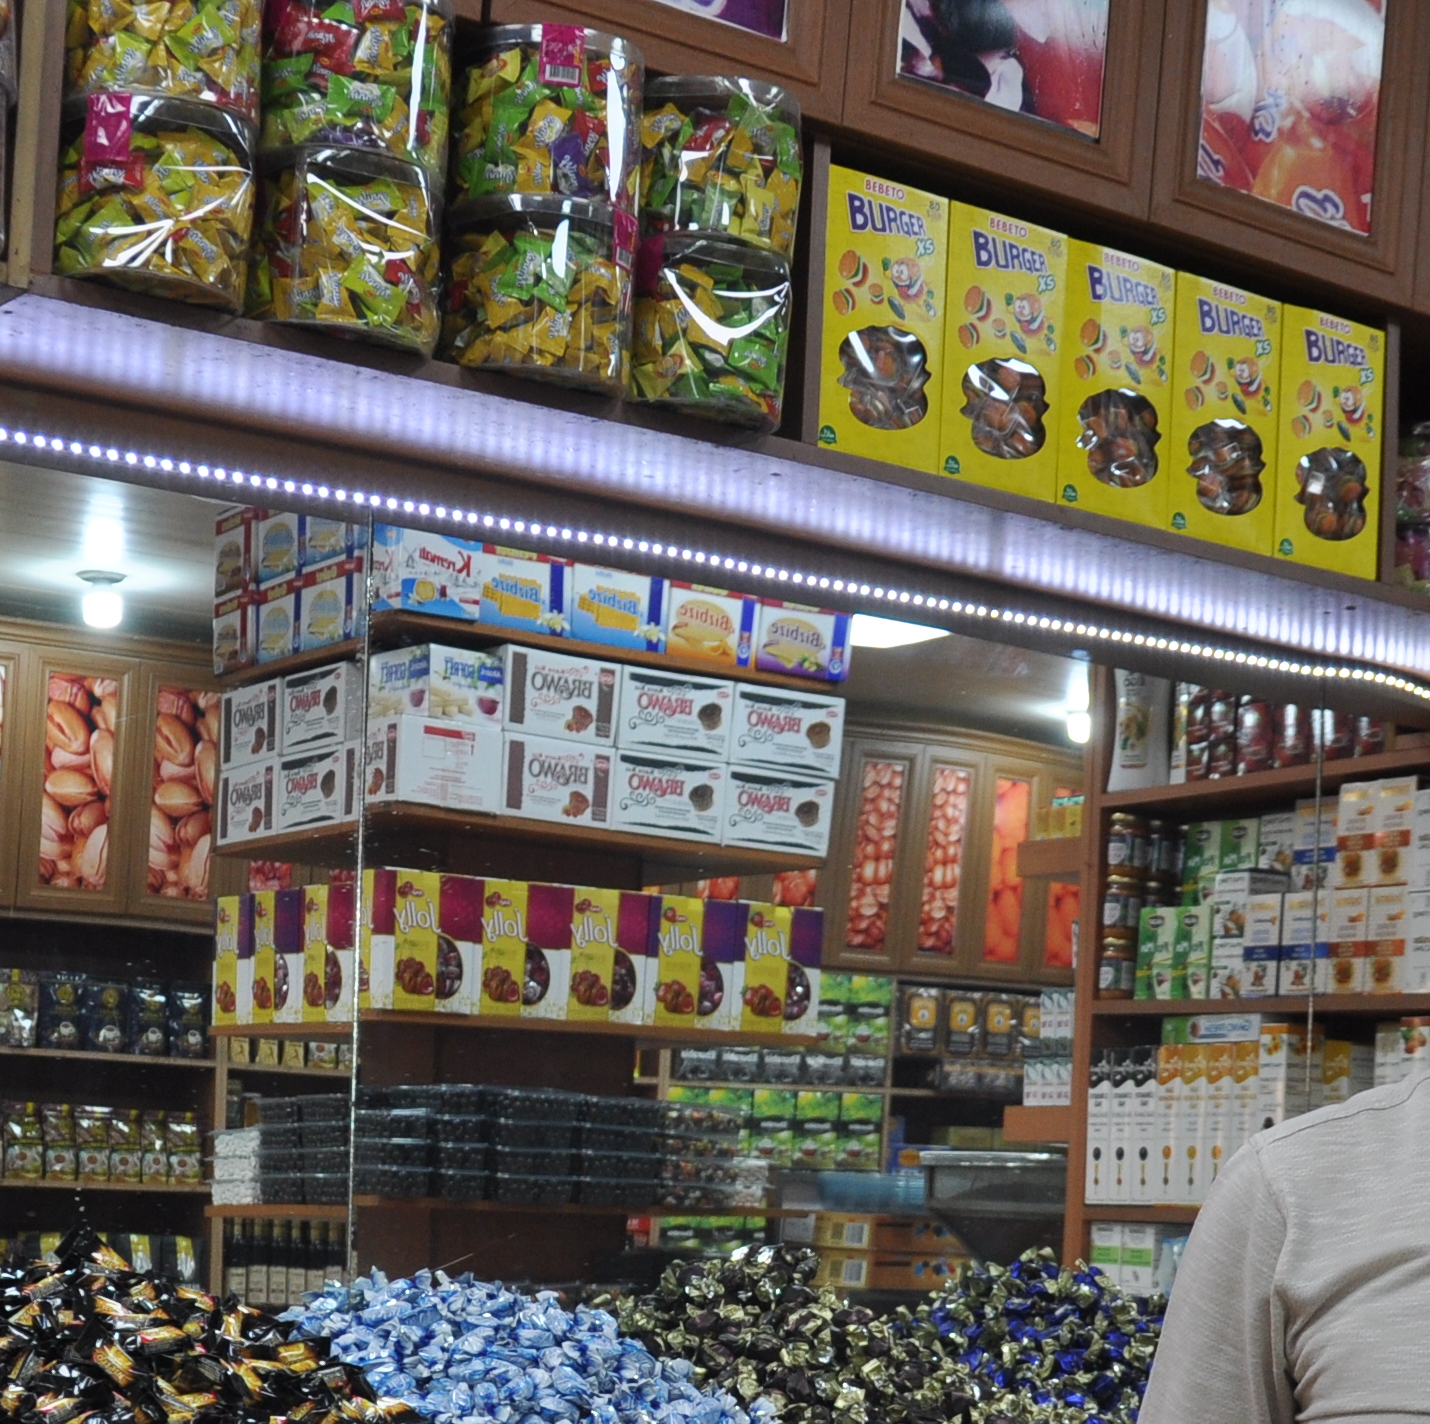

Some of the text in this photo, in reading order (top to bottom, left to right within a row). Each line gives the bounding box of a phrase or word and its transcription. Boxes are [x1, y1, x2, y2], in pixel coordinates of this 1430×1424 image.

[865, 178, 905, 200] BEBETO
[847, 191, 926, 236] BURGER
[989, 216, 1028, 238] BEBETO
[915, 238, 935, 257] XS
[973, 229, 1048, 275] BURGER
[1103, 253, 1140, 272] BEBETO
[1037, 274, 1056, 292] XS
[1086, 263, 1159, 308] BURGER
[1212, 285, 1247, 305] BEBETO
[1149, 306, 1167, 326] XS
[1197, 297, 1265, 339] BURGER
[1319, 316, 1352, 335] BEBETO
[1255, 339, 1272, 357] XS
[1303, 326, 1369, 367] BURGER
[1359, 367, 1375, 386] XS
